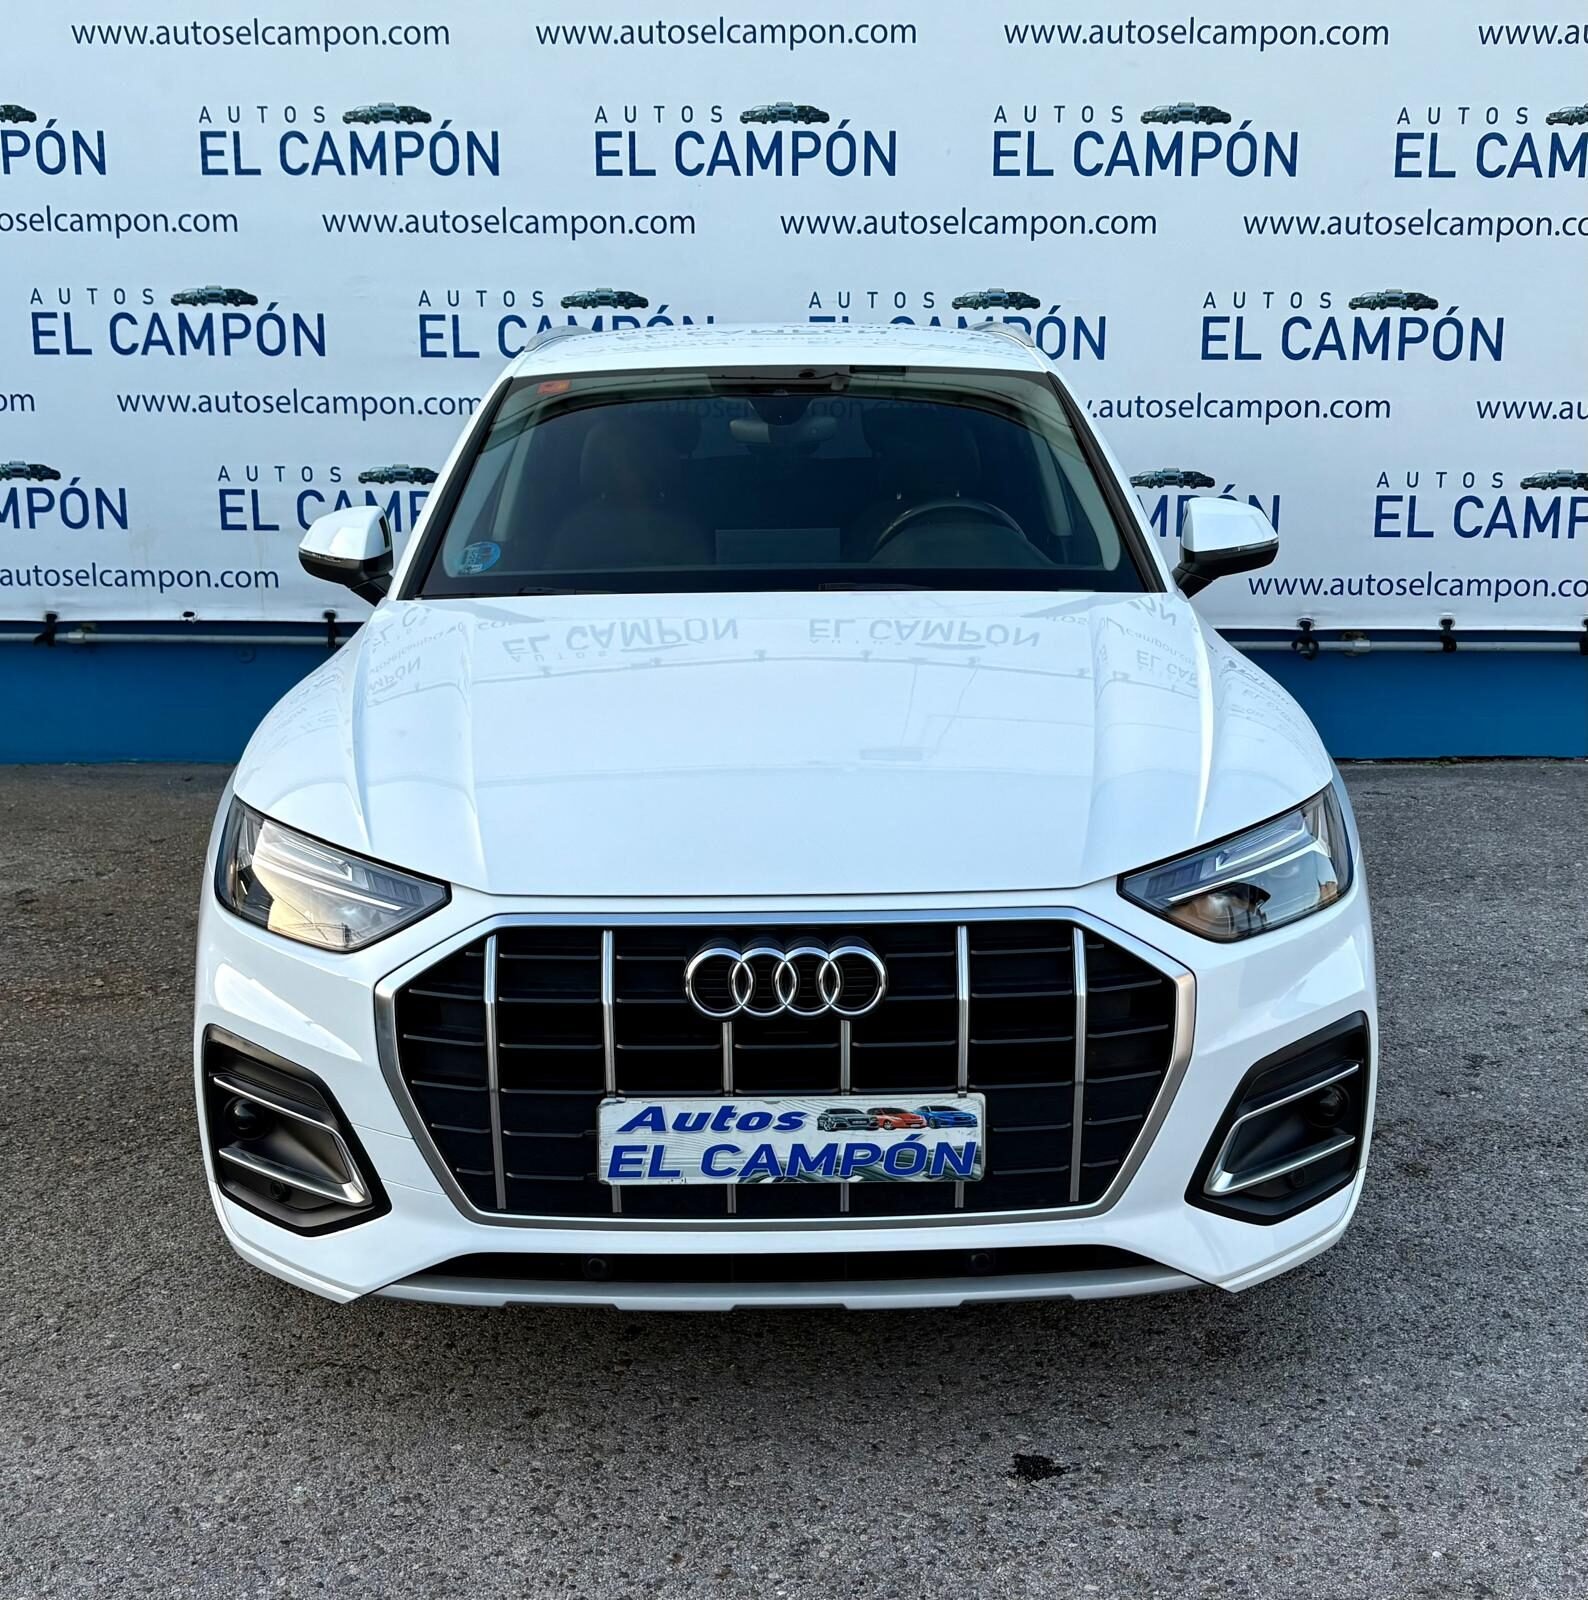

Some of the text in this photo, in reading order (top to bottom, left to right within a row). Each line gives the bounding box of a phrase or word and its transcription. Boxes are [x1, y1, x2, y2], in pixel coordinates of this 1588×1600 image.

[71, 18, 450, 52] www.autoselcampon.com
[536, 16, 917, 51] www.autoselcampon.com
[1004, 17, 1389, 52] www.autoselcampon.com
[199, 105, 326, 124] AUTOS
[595, 105, 723, 124] AUTOS
[994, 105, 1124, 124] AUTOS
[1397, 106, 1529, 125] AUTOS
[200, 120, 500, 177] EL CAMPÓN
[595, 120, 897, 177] EL CAMPÓN
[993, 120, 1299, 177] EL CAMPÓN
[1394, 132, 1588, 178] EL CAM
[322, 207, 696, 241] www.autoselcampon.com
[780, 207, 1157, 241] www.autoselcampon.com
[30, 288, 155, 306] AUTOS
[418, 290, 544, 308] AUTOS
[809, 291, 935, 309] AUTOS
[1203, 291, 1332, 310] AUTOS
[31, 303, 326, 358] EL CAMPÓN
[419, 314, 480, 359] EL
[1201, 307, 1505, 362] EL CAMPÓN
[1087, 392, 1391, 425] .autoselcampon.com
[218, 465, 342, 483] AUTOS
[1377, 471, 1504, 489] AUTOS
[219, 489, 280, 531] EL
[1374, 495, 1435, 539] EL
[0, 562, 280, 594] autoselcampon.com
[617, 1105, 806, 1132] Autos
[607, 1134, 977, 1178] EL CAMPÓN
